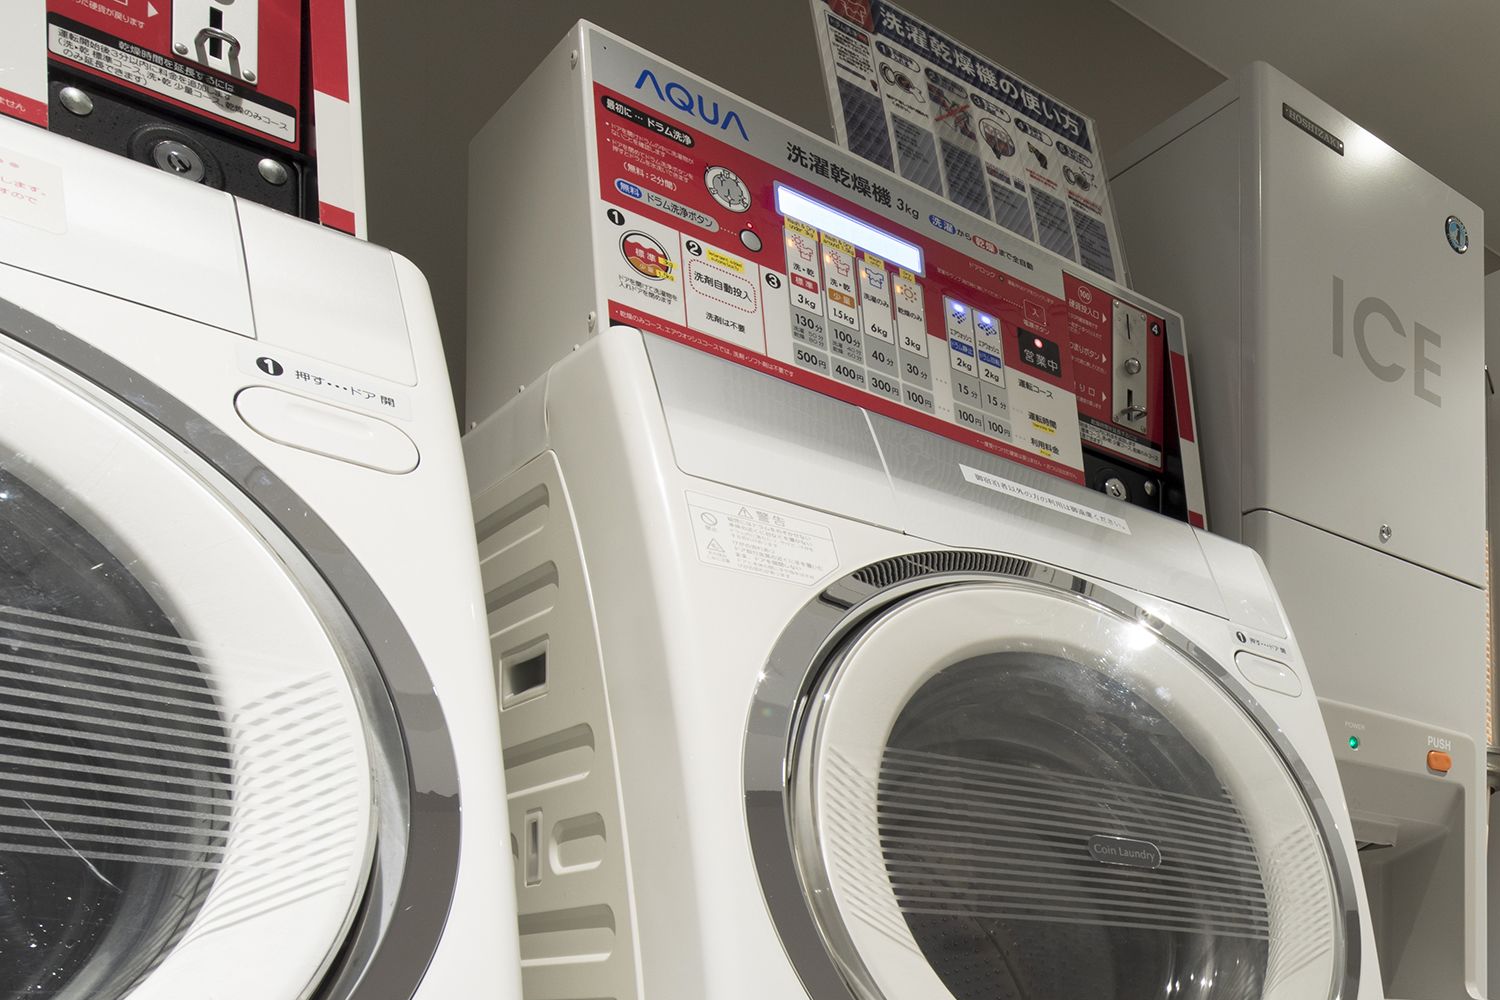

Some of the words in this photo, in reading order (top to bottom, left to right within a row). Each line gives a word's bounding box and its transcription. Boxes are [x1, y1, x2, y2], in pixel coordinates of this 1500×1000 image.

[879, 7, 1081, 138] 洗濯乾燥機の使い方
[634, 69, 750, 142] AQUA
[1287, 108, 1342, 150] HOSHIZAKI
[787, 141, 892, 210] 洗濯乾燥機
[895, 198, 920, 220] 3kg
[647, 192, 713, 228] ドラム洗浄ボタン
[693, 271, 752, 303] 洗剤自動投入
[797, 294, 817, 310] 3kg
[705, 311, 746, 334] 洗剤は不要
[870, 323, 889, 338] 6kg
[904, 337, 921, 351] 3kg
[1332, 274, 1442, 409] ICE
[796, 349, 827, 370] 500円
[871, 350, 894, 368] 40分
[956, 357, 973, 372] 2kg
[1023, 348, 1059, 372] 営業中
[835, 364, 864, 384] 400円
[906, 363, 928, 380] 30分
[984, 368, 1000, 383] 2kg
[871, 377, 900, 397] 300円
[957, 382, 978, 400] 15分
[1018, 378, 1054, 400] 運転コース
[906, 390, 932, 409] 100円
[986, 393, 1007, 411] 15分
[957, 409, 982, 428] 100円
[1028, 411, 1057, 430] 運転時間
[987, 420, 1011, 438] 100円
[1030, 437, 1060, 455] 利用料金
[1427, 735, 1452, 751] PUSH
[1093, 843, 1117, 856] Coin
[1118, 846, 1155, 863] Laundry
